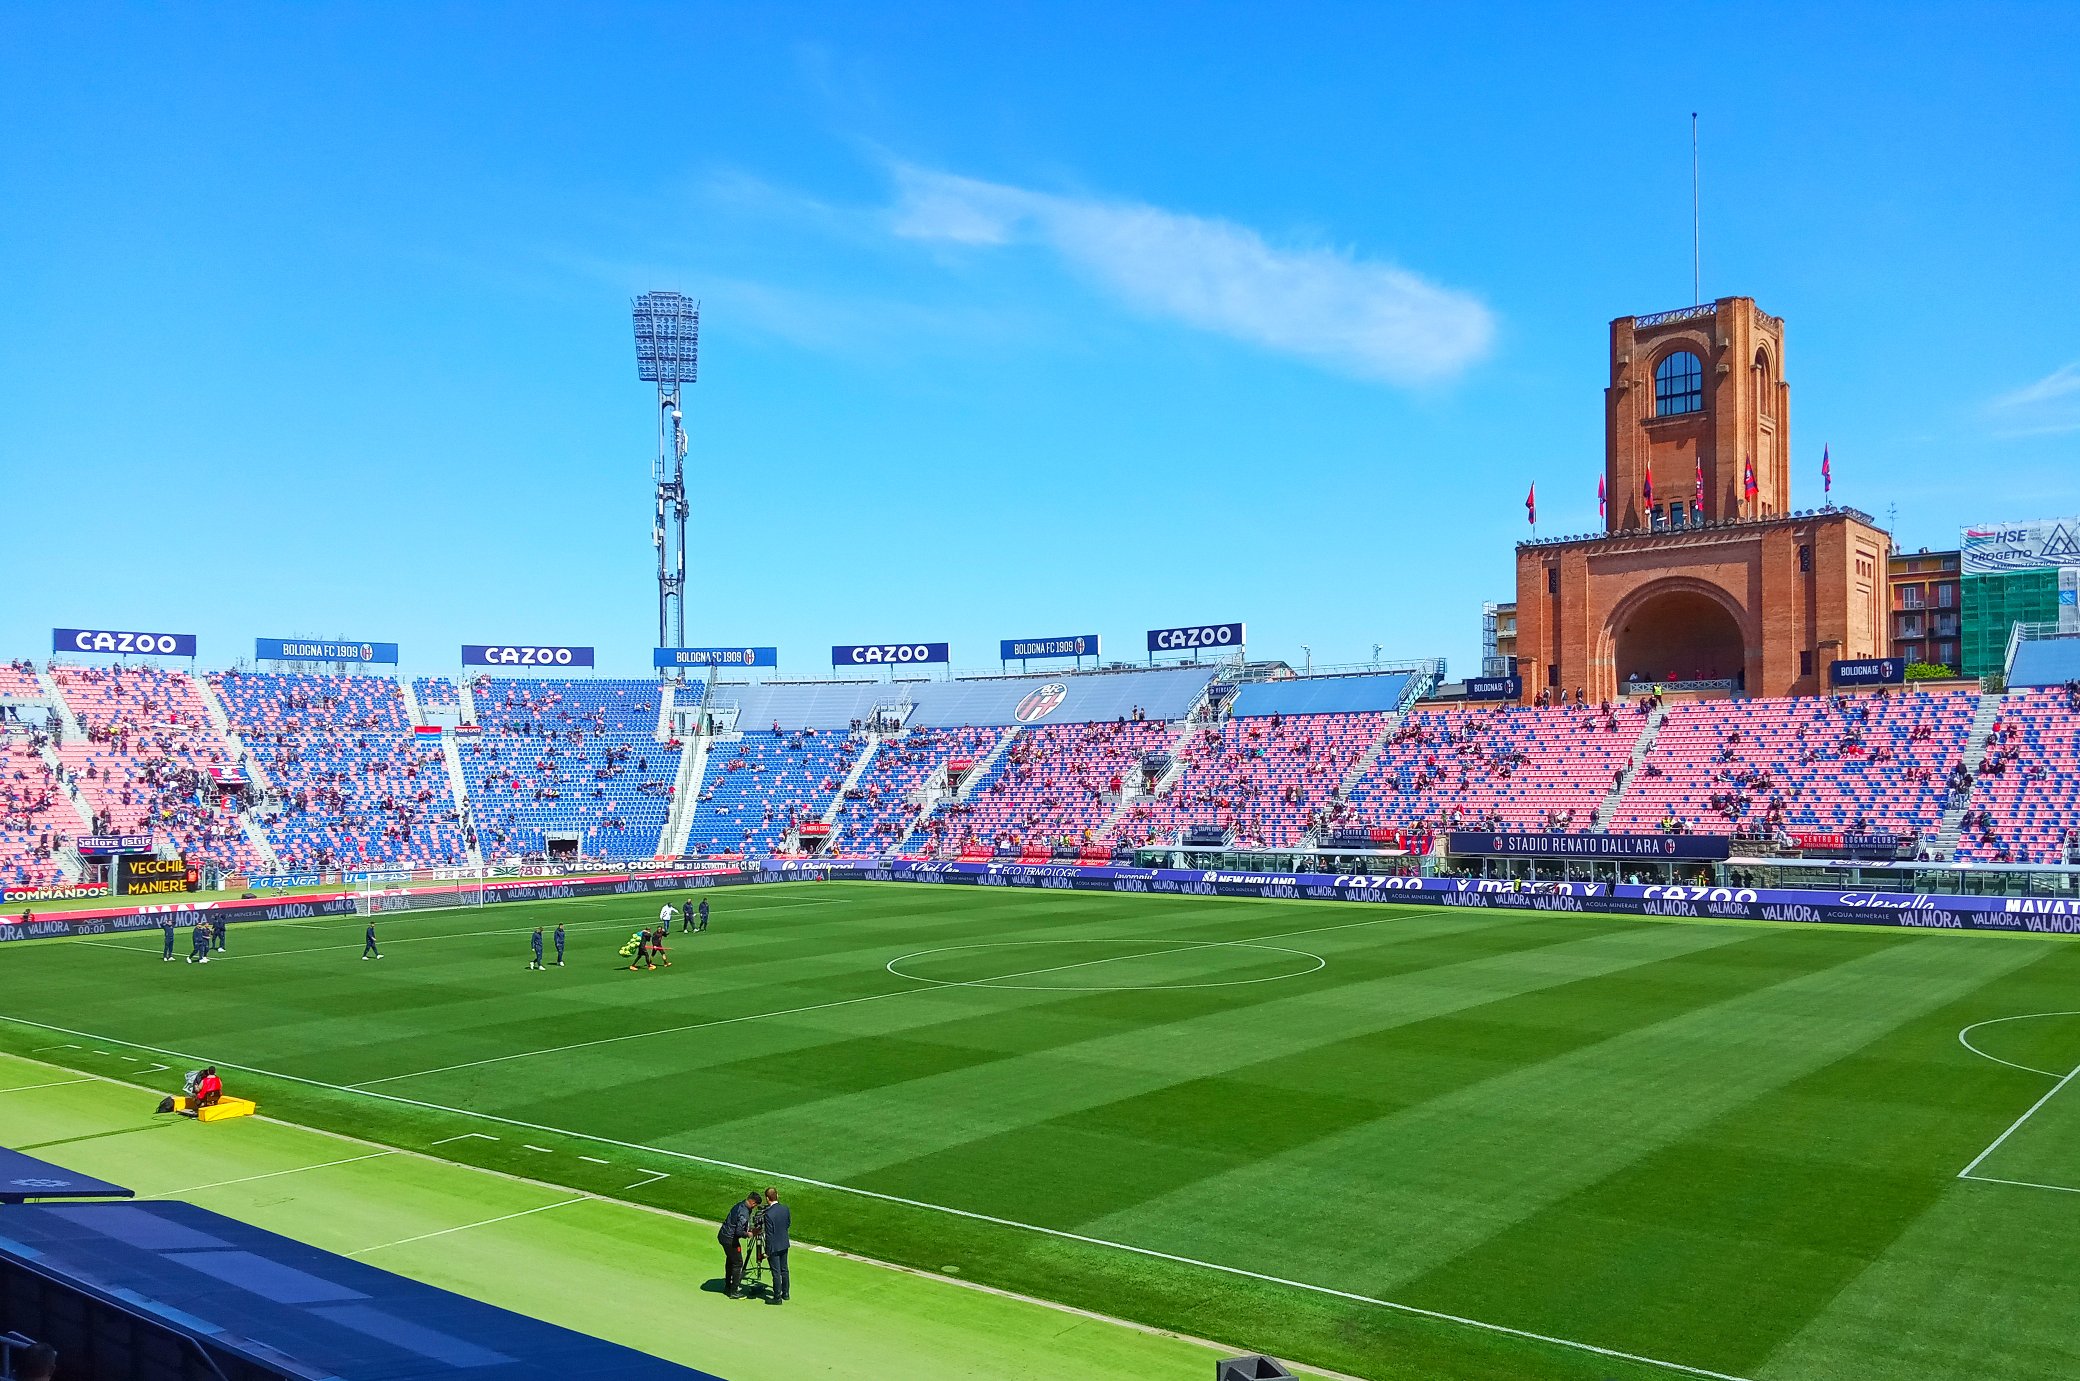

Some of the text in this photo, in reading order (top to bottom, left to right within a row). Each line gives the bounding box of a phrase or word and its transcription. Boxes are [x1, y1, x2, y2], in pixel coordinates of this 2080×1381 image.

[1996, 529, 2028, 544] HSE
[1971, 550, 2032, 562] PROGETTO
[75, 632, 177, 653] CAZOO
[1157, 626, 1232, 648] CAZOO
[283, 643, 358, 657] BOLOGNA FC 1909
[852, 645, 929, 663] CAZOO
[1014, 640, 1073, 655] BOLOGNA FC 1909
[484, 647, 572, 664] CAZOO
[676, 651, 711, 663] BOLOGNA
[723, 651, 742, 663] 1909
[1841, 666, 1871, 677] BOLOGNA
[1474, 683, 1498, 693] BOLOGNA
[1508, 836, 1660, 853] STADIO RENATO DALL'ARA
[1803, 835, 1831, 843] CENTRO
[129, 860, 186, 875] VECCHIE
[564, 862, 626, 871] VECCHIO
[627, 861, 673, 870] CUORE
[1001, 866, 1022, 875] ECO
[684, 876, 715, 888] VALMORA
[752, 871, 784, 883] VALMORA
[788, 870, 825, 881] VALMORA
[864, 870, 893, 881] VALMORA
[893, 871, 915, 880] VALMORA
[916, 871, 945, 883] VALMORA
[976, 874, 1007, 886] VALMORA
[1012, 875, 1035, 885] VALMORA
[1217, 875, 1297, 885] NEW HOLLAND
[128, 879, 187, 895] MANIERE
[614, 880, 649, 893] VALMORA
[653, 878, 678, 888] VALMORA
[1041, 876, 1073, 889] VALMORA
[1113, 879, 1148, 892] VALMORA
[1152, 880, 1179, 890] VALMORA
[1180, 882, 1217, 895] VALMORA
[1333, 875, 1423, 890] CAZOO
[3, 887, 108, 902] COMMANDOS
[507, 887, 536, 898] VALMORA
[538, 885, 574, 899] VALMORA
[1260, 884, 1300, 898] VALMORA
[1306, 885, 1337, 897] VALMORA
[1345, 888, 1387, 903] VALMORA
[1643, 886, 1758, 903] CAZOO
[1441, 892, 1488, 907] VALMORA
[1494, 893, 1531, 905] VALMORA
[1533, 895, 1583, 911] VALMORA
[266, 903, 314, 920] VALMORA
[1643, 900, 1698, 916] VALMORA
[1707, 901, 1750, 915] VALMORA
[1761, 903, 1821, 922] VALMORA
[112, 914, 153, 928] VALMORA
[1856, 912, 1890, 920] MINERALE
[1898, 909, 1962, 928] VALMORA
[1972, 912, 2021, 926] VALMORA
[28, 921, 70, 935] VALMORA
[78, 924, 105, 935] 00:00
